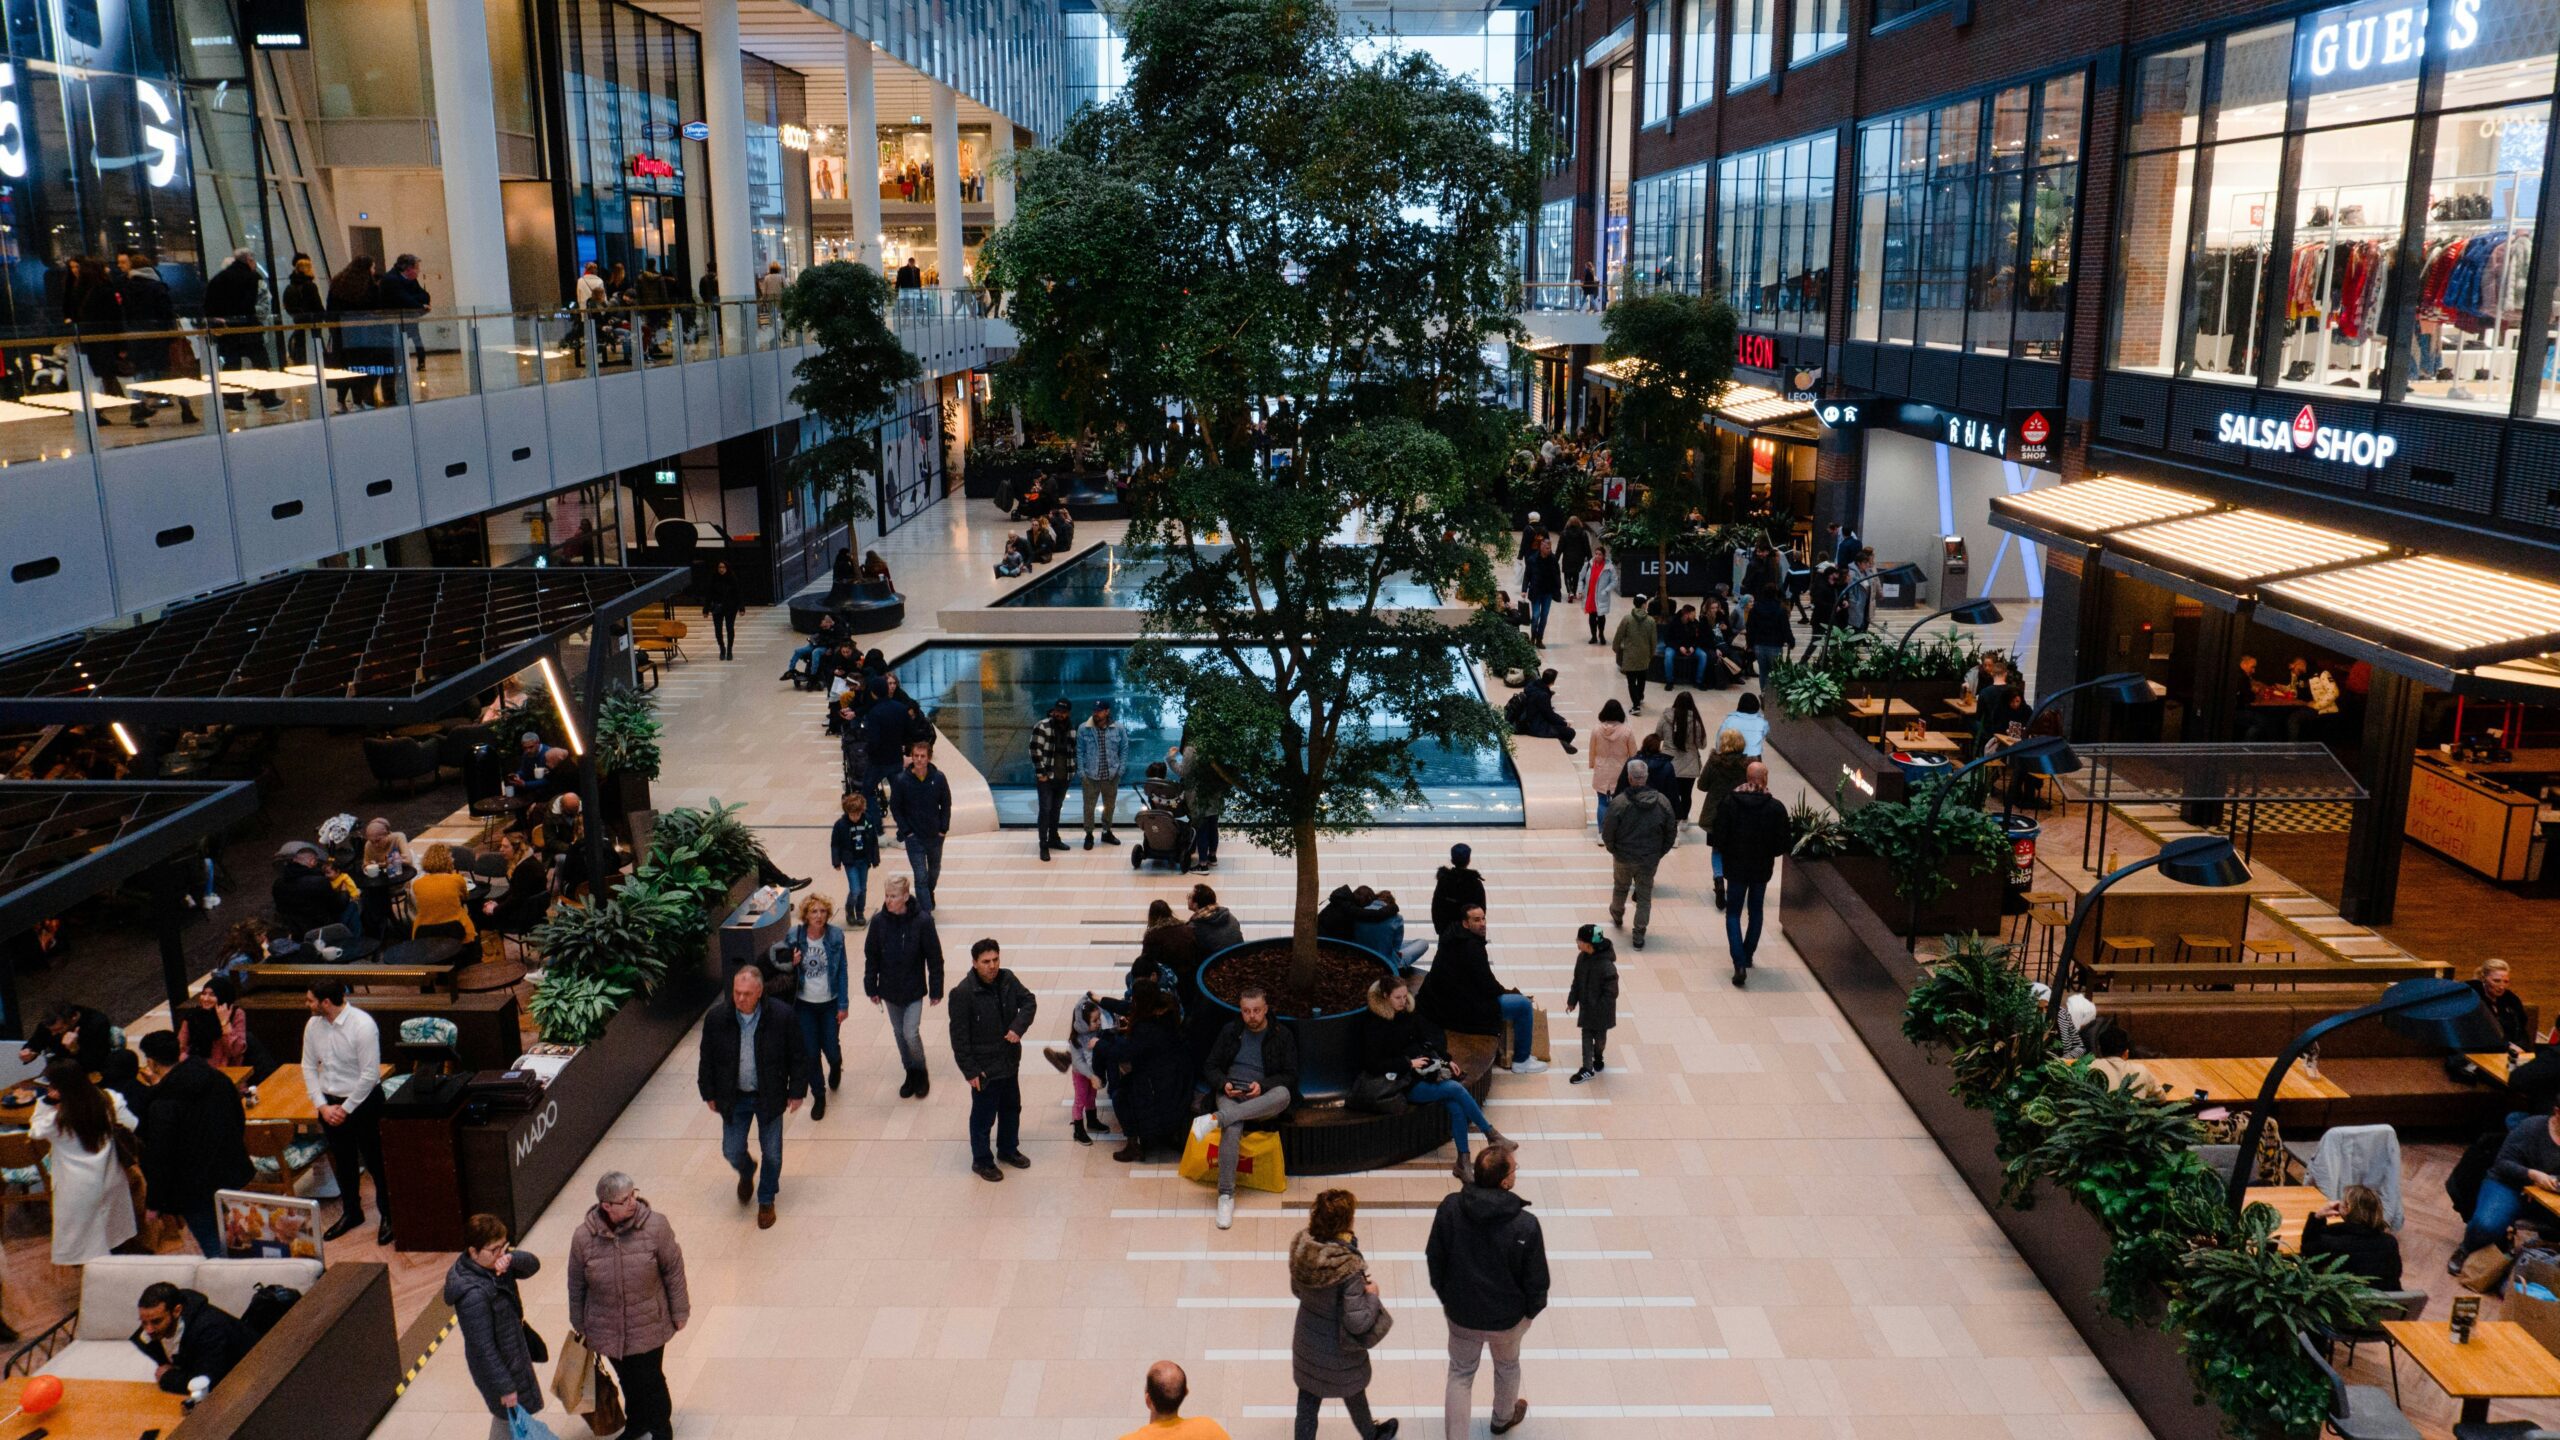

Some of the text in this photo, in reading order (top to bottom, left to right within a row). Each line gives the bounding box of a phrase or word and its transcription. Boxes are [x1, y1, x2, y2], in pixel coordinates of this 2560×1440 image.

[1739, 335, 1774, 369] LEON
[1787, 392, 1817, 402] LEON
[2218, 412, 2397, 468] SALSA SHOP
[2022, 452, 2046, 460] SHOP
[1641, 561, 1689, 575] LEON
[516, 1100, 558, 1168] MADO
